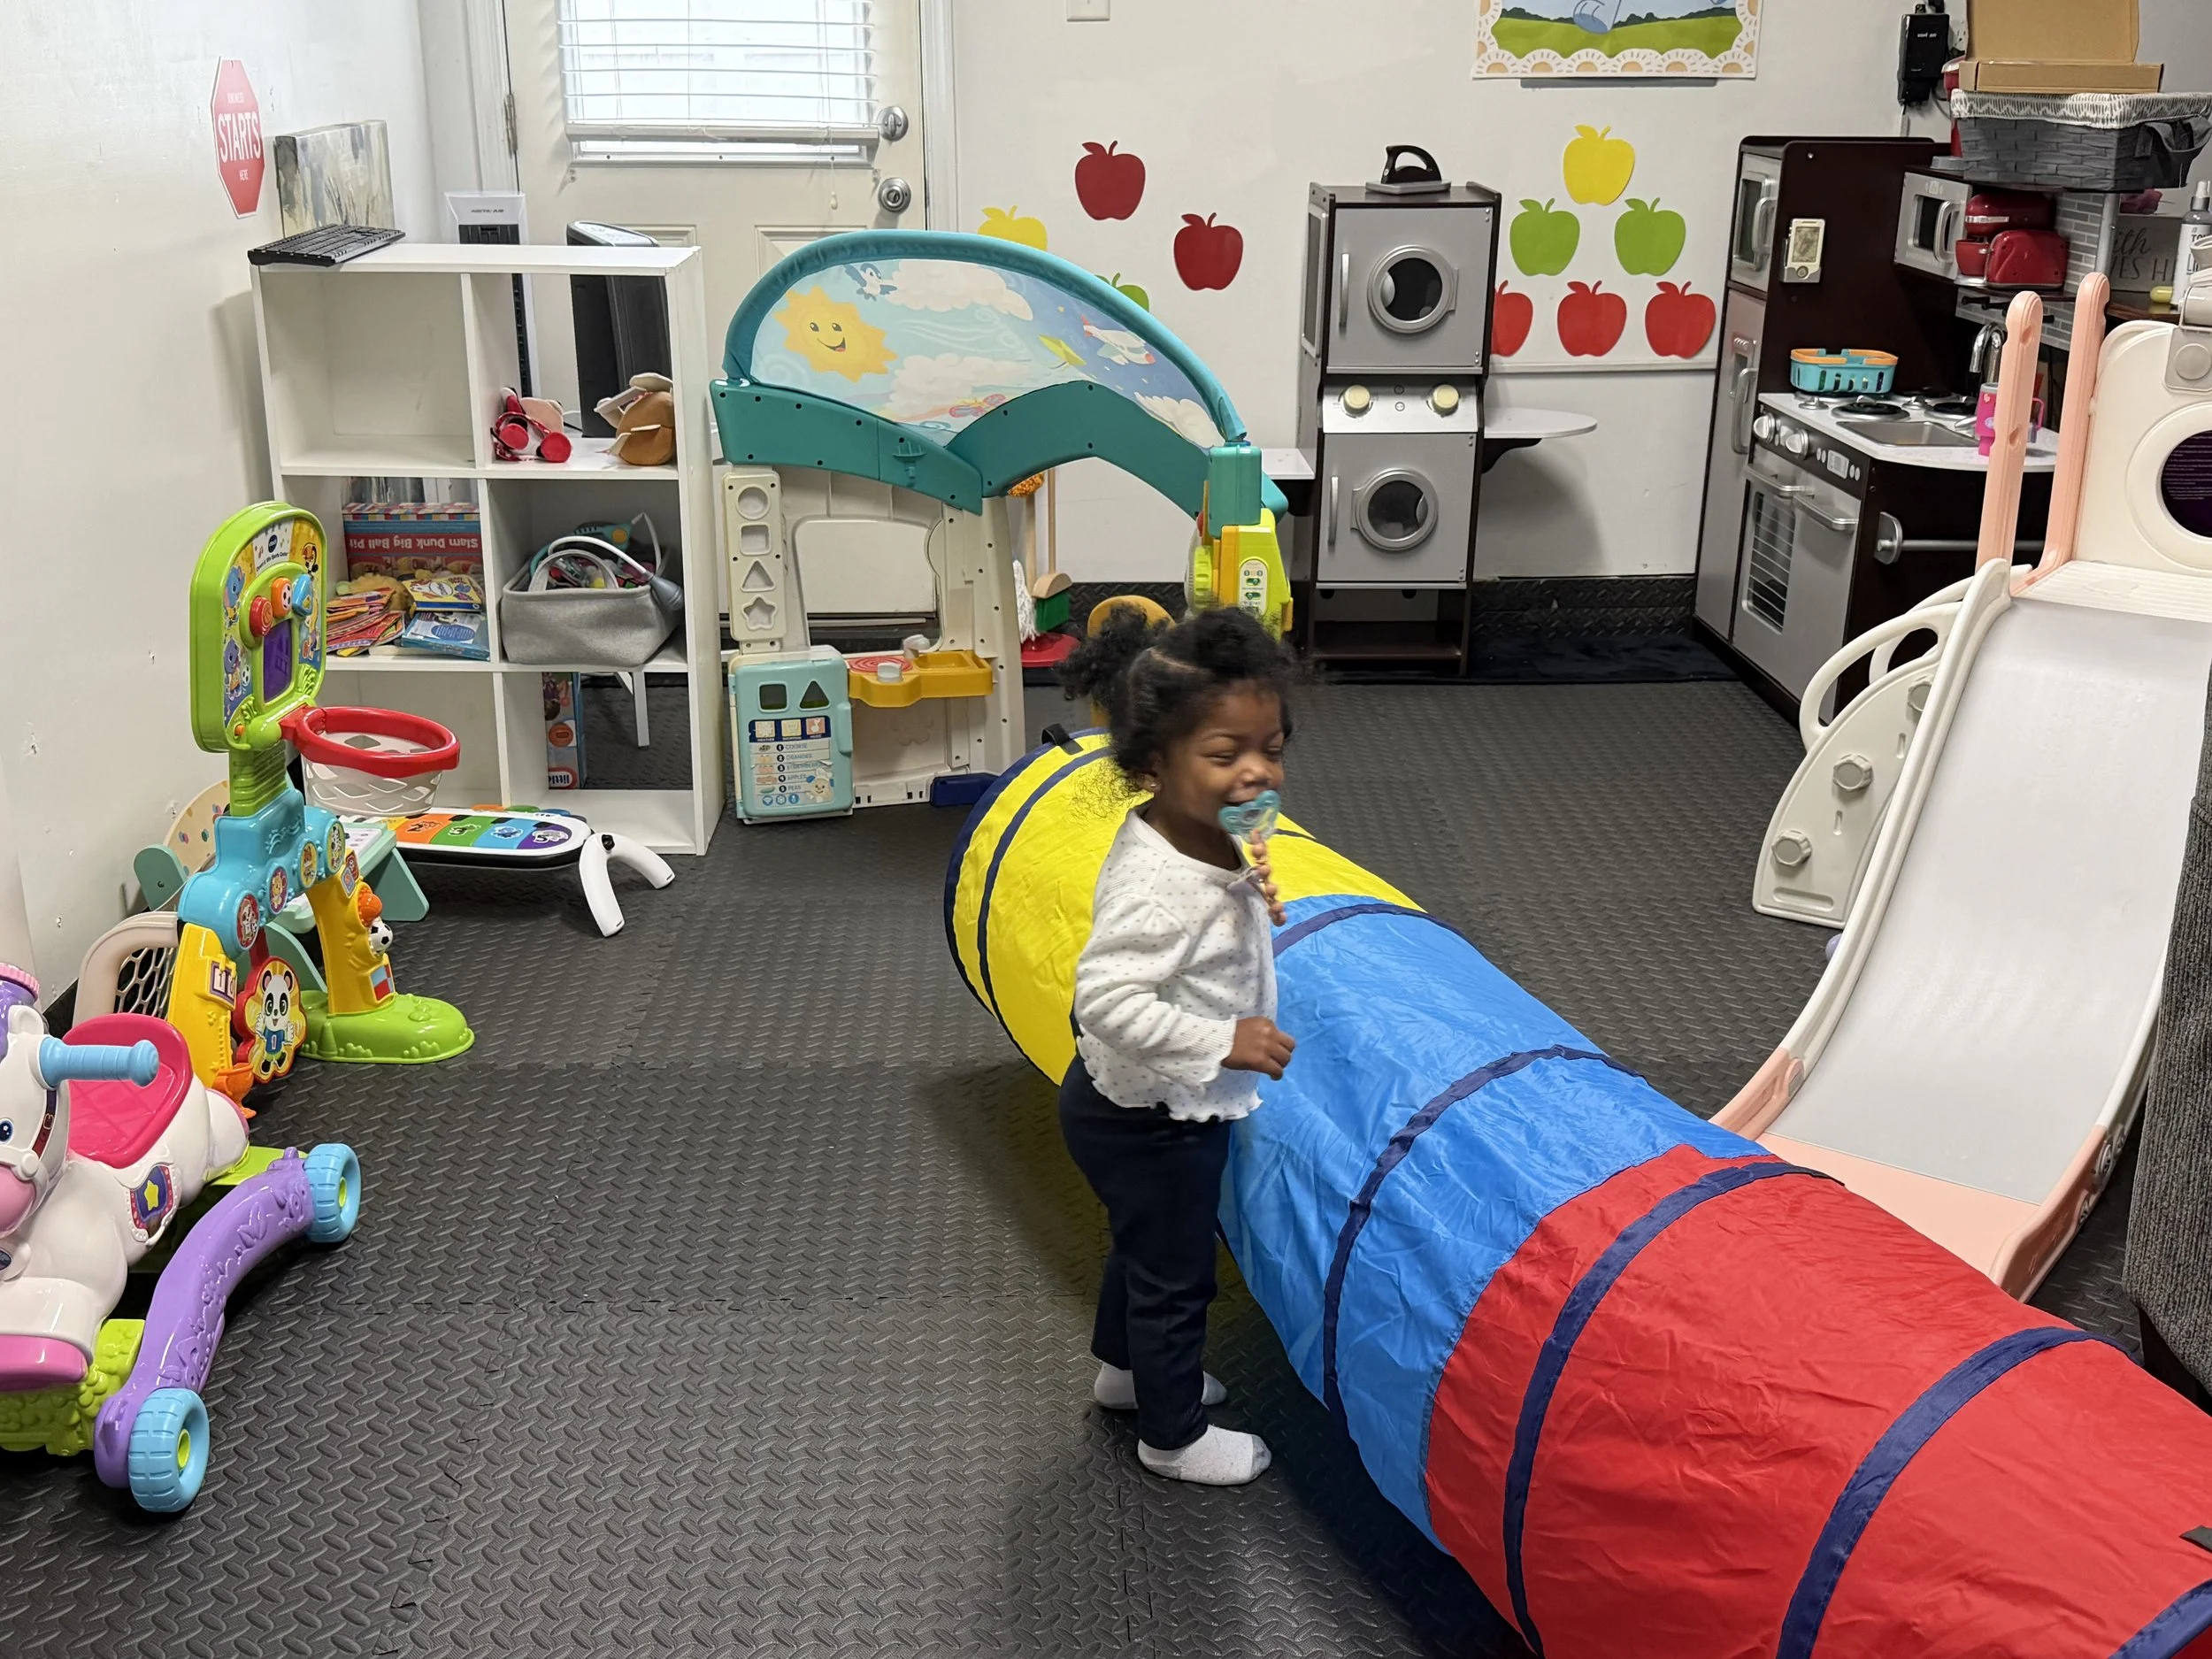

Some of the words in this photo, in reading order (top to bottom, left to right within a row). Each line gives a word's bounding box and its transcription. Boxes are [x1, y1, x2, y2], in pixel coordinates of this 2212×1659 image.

[218, 111, 261, 163] STARTS
[2112, 227, 2151, 256] ith
[349, 538, 365, 549] Pit
[368, 538, 390, 549] Ball
[393, 535, 412, 549] Big
[416, 538, 446, 549] Dunk
[449, 538, 479, 549] Slam
